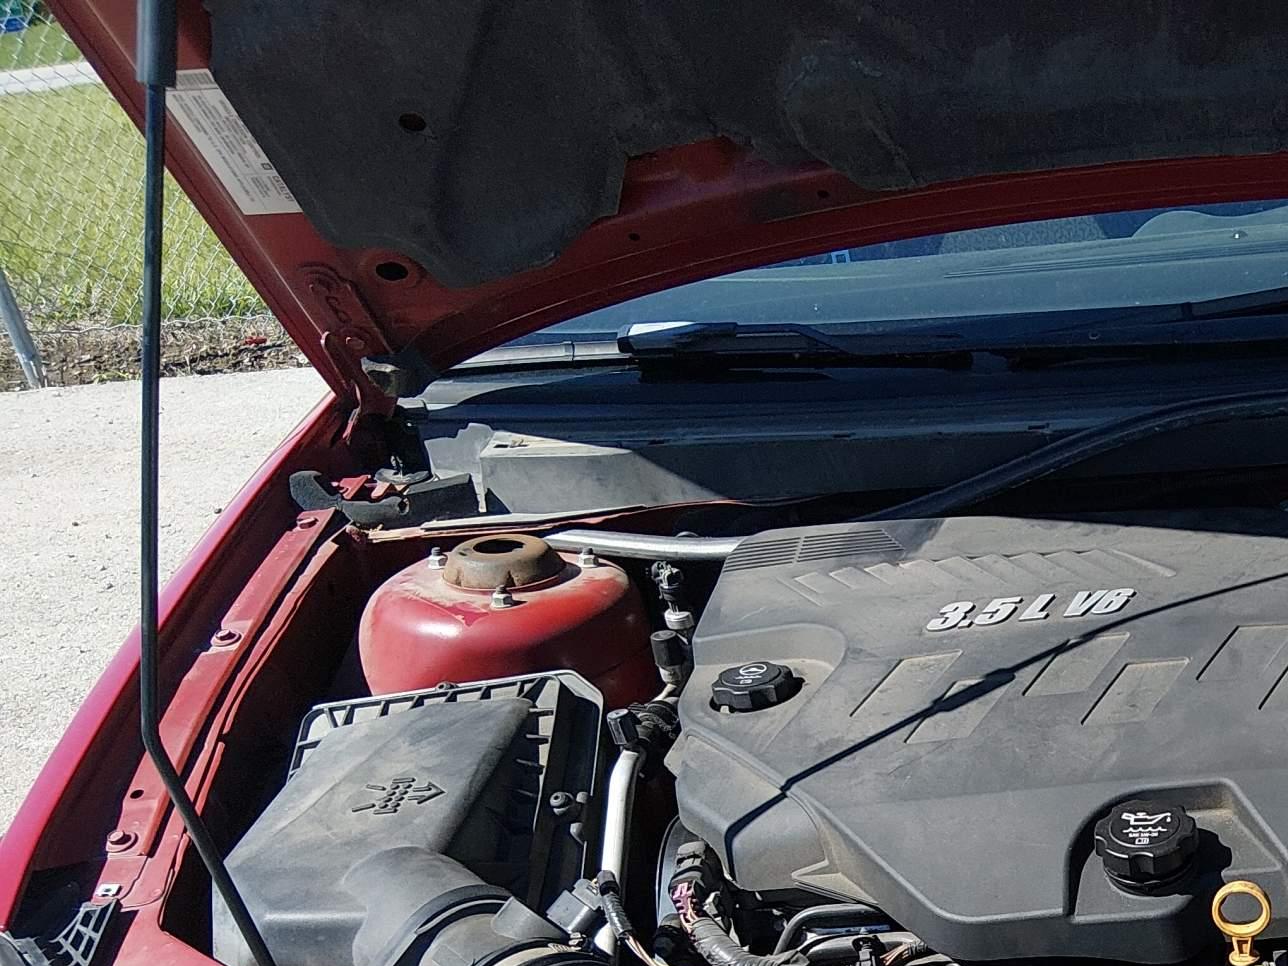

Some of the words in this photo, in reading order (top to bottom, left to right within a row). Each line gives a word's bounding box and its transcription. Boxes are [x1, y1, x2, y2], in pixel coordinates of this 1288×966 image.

[926, 597, 1024, 631] 3.5
[1018, 593, 1056, 621] L
[1063, 588, 1137, 618] V6
